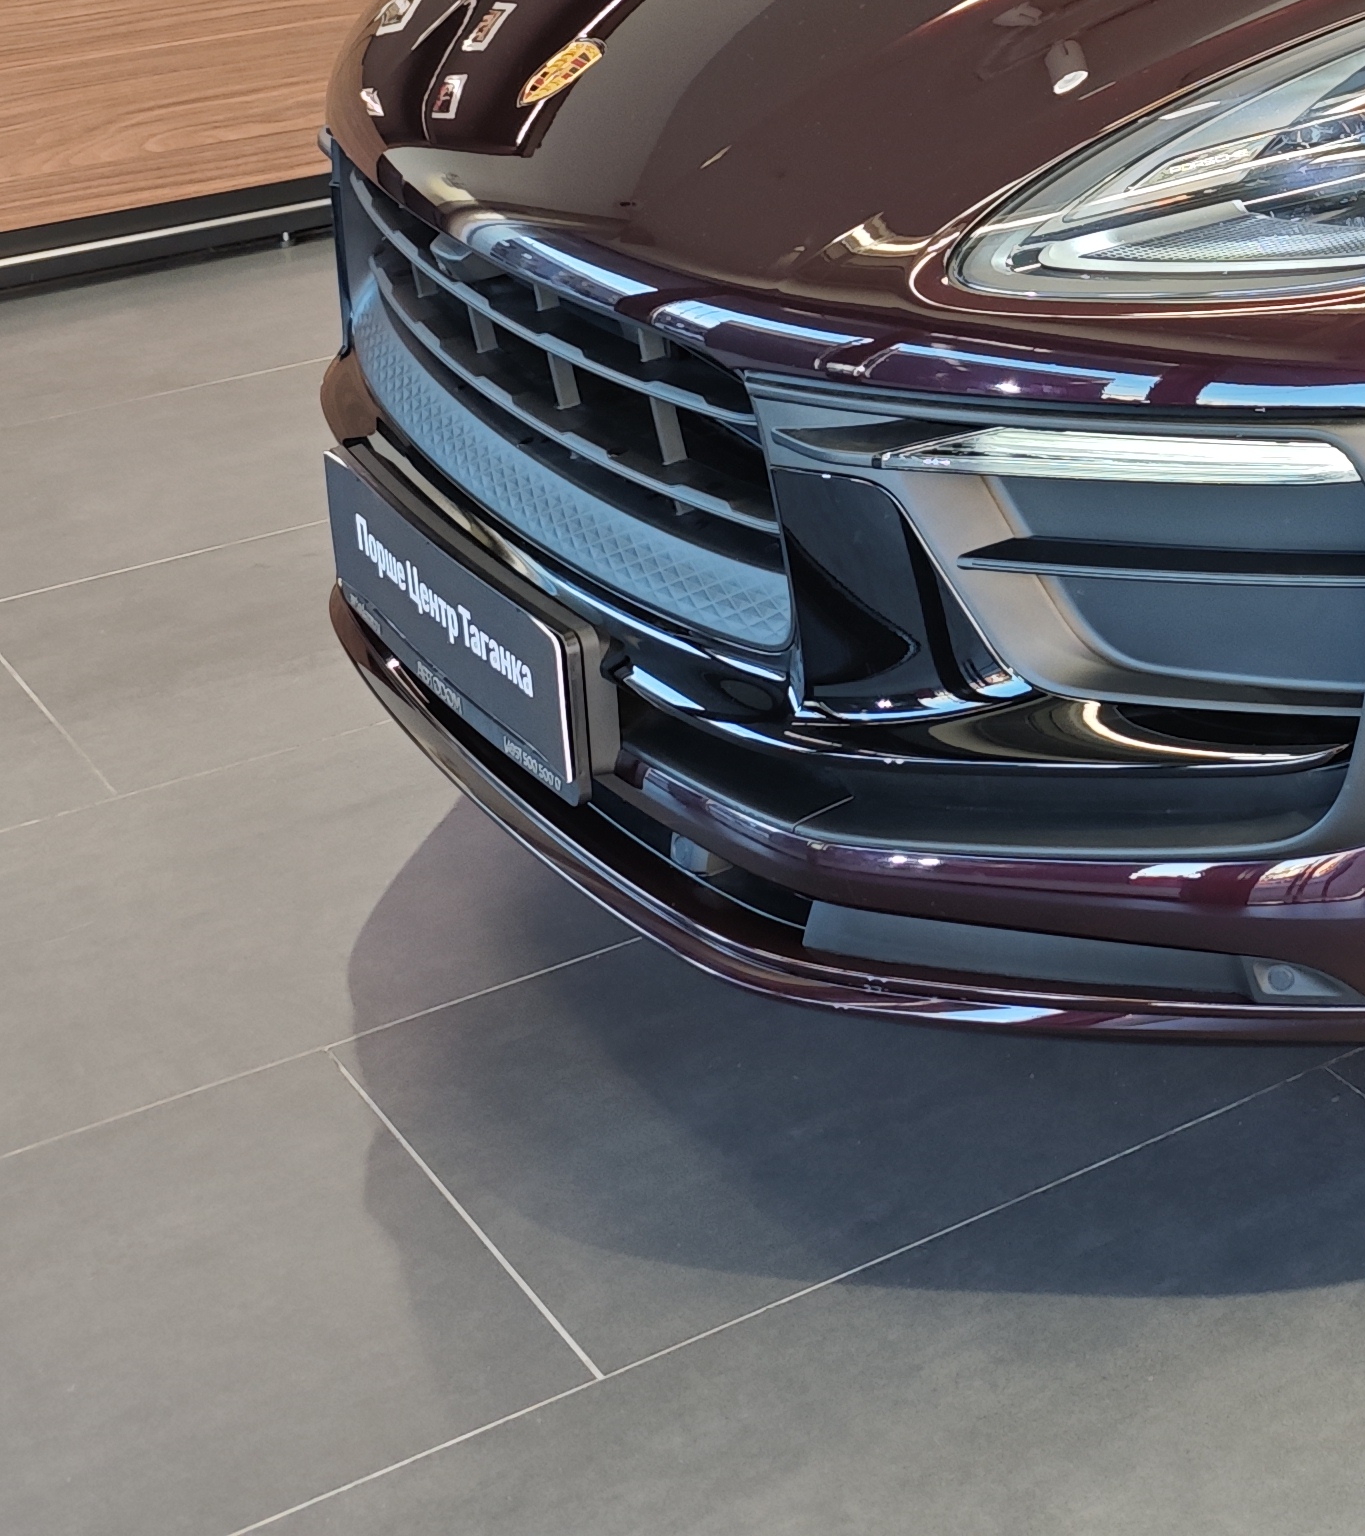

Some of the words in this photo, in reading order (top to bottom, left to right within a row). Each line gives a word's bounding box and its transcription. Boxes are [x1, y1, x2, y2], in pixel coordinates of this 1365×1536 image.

[355, 513, 406, 592] Порше
[406, 560, 459, 645] Центр
[458, 604, 534, 698] Таганка
